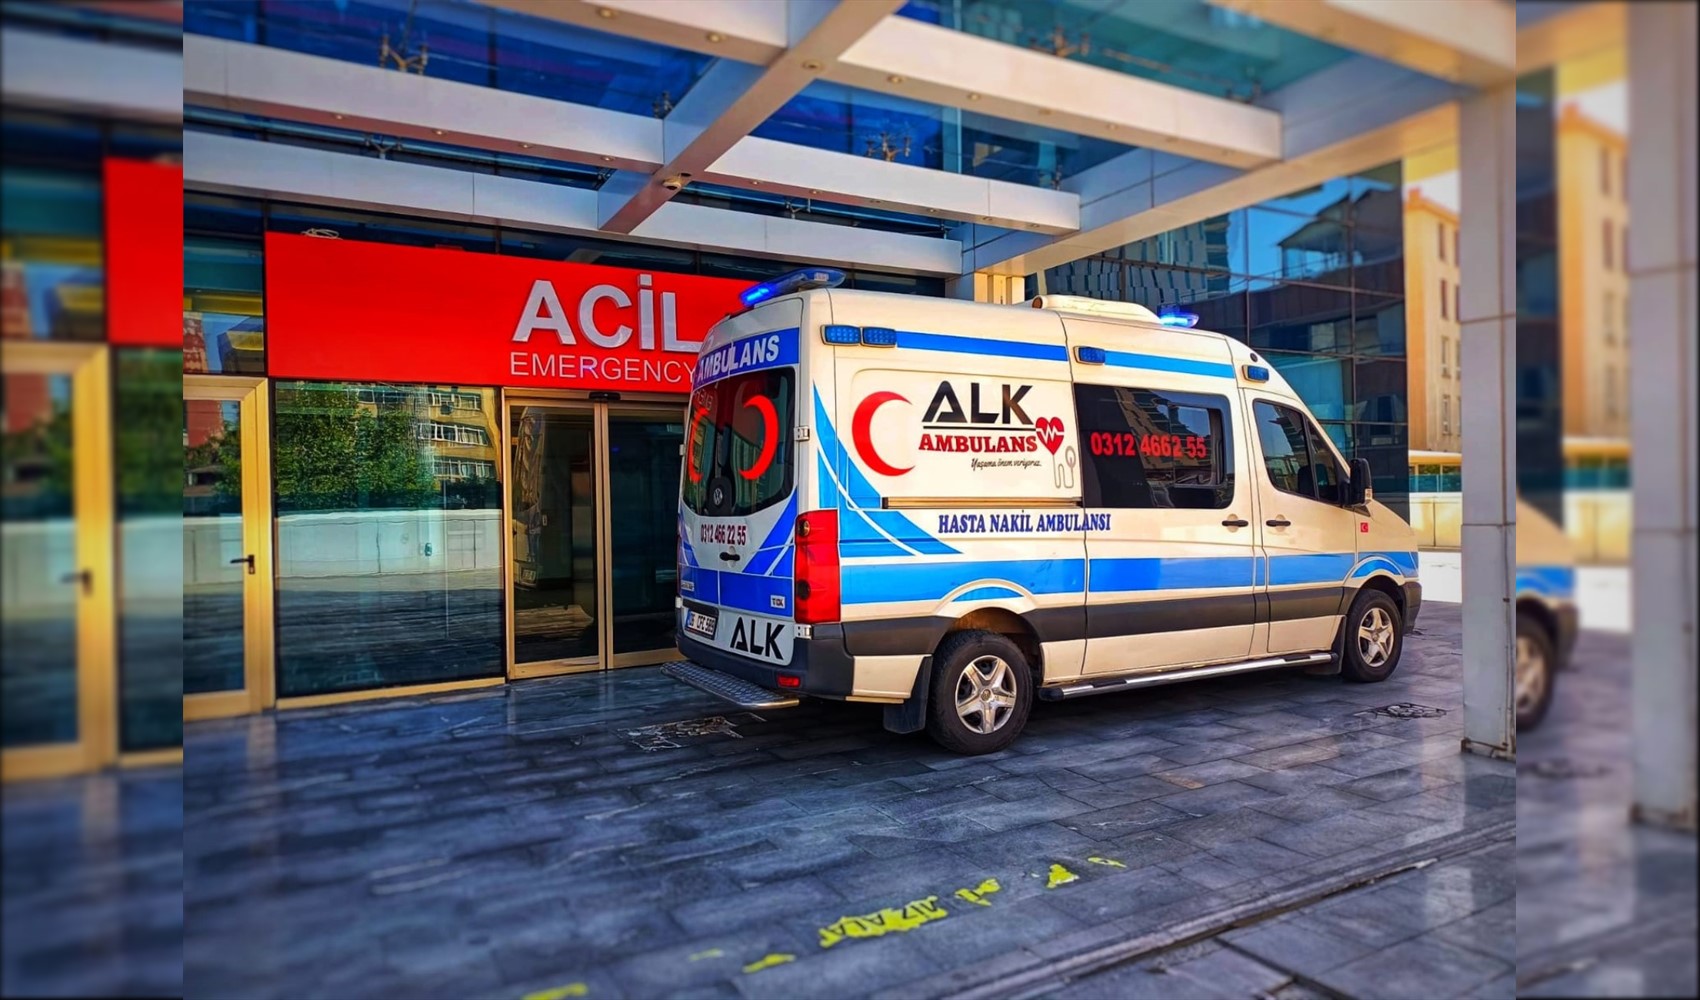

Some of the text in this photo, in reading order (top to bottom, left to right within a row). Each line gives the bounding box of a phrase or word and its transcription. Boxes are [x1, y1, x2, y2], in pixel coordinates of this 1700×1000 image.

[511, 273, 703, 353] ACİL
[510, 351, 696, 384] EMERGENCY
[697, 334, 780, 383] AMBULANS
[921, 380, 1034, 425] ALK
[918, 433, 1038, 453] AMBULANS
[1090, 432, 1136, 456] 0312
[1186, 436, 1207, 458] 55
[700, 523, 747, 546] 0312 466 22 55
[938, 509, 1111, 533] HASTA NAKİL AMBULANSI
[730, 616, 786, 660] ALK
